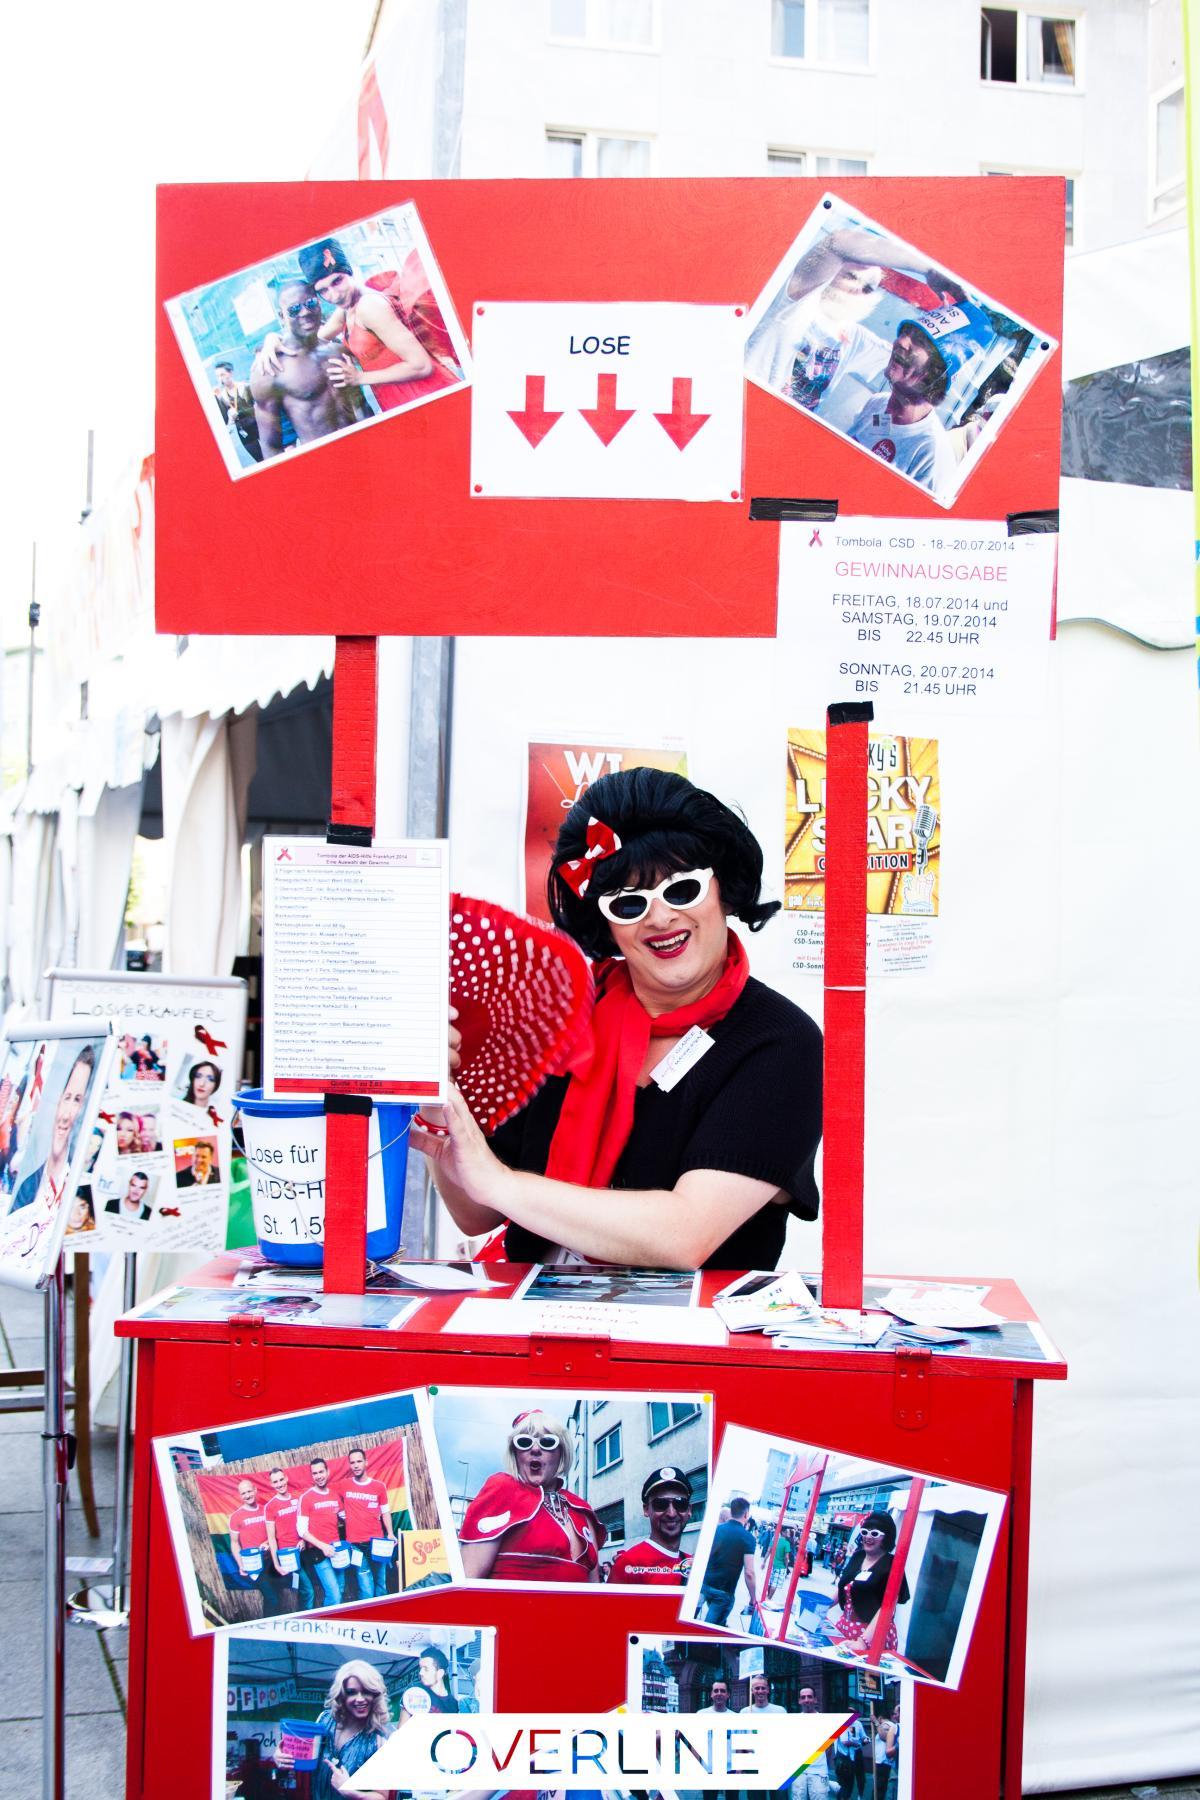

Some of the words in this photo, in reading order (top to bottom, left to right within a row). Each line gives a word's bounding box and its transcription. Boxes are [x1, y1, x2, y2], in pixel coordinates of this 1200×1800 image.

[570, 336, 631, 355] LOSE
[835, 536, 882, 548] Tombola
[889, 537, 915, 549] CSD
[835, 561, 1008, 582] GEWINNAUSGABE
[832, 594, 900, 609] FREITAG,
[906, 596, 979, 611] 18.07.2014
[984, 599, 1009, 612] und
[841, 611, 918, 627] SAMSTAG,
[924, 614, 997, 628] 19.07.2014
[857, 629, 881, 642] BIS
[906, 631, 943, 644] 22.45
[948, 632, 980, 645] UHR
[839, 663, 916, 678] SONNTAG,
[921, 666, 995, 679] 20.07.2014
[855, 680, 879, 692] BIS
[903, 682, 940, 695] 21.45
[945, 684, 977, 696] UHR
[811, 815, 915, 853] SAR
[289, 1144, 318, 1164] für
[257, 1179, 324, 1200] AIDS-H
[263, 1214, 283, 1236] St.
[291, 1215, 326, 1239] 1,5
[361, 1628, 389, 1646] e.V.
